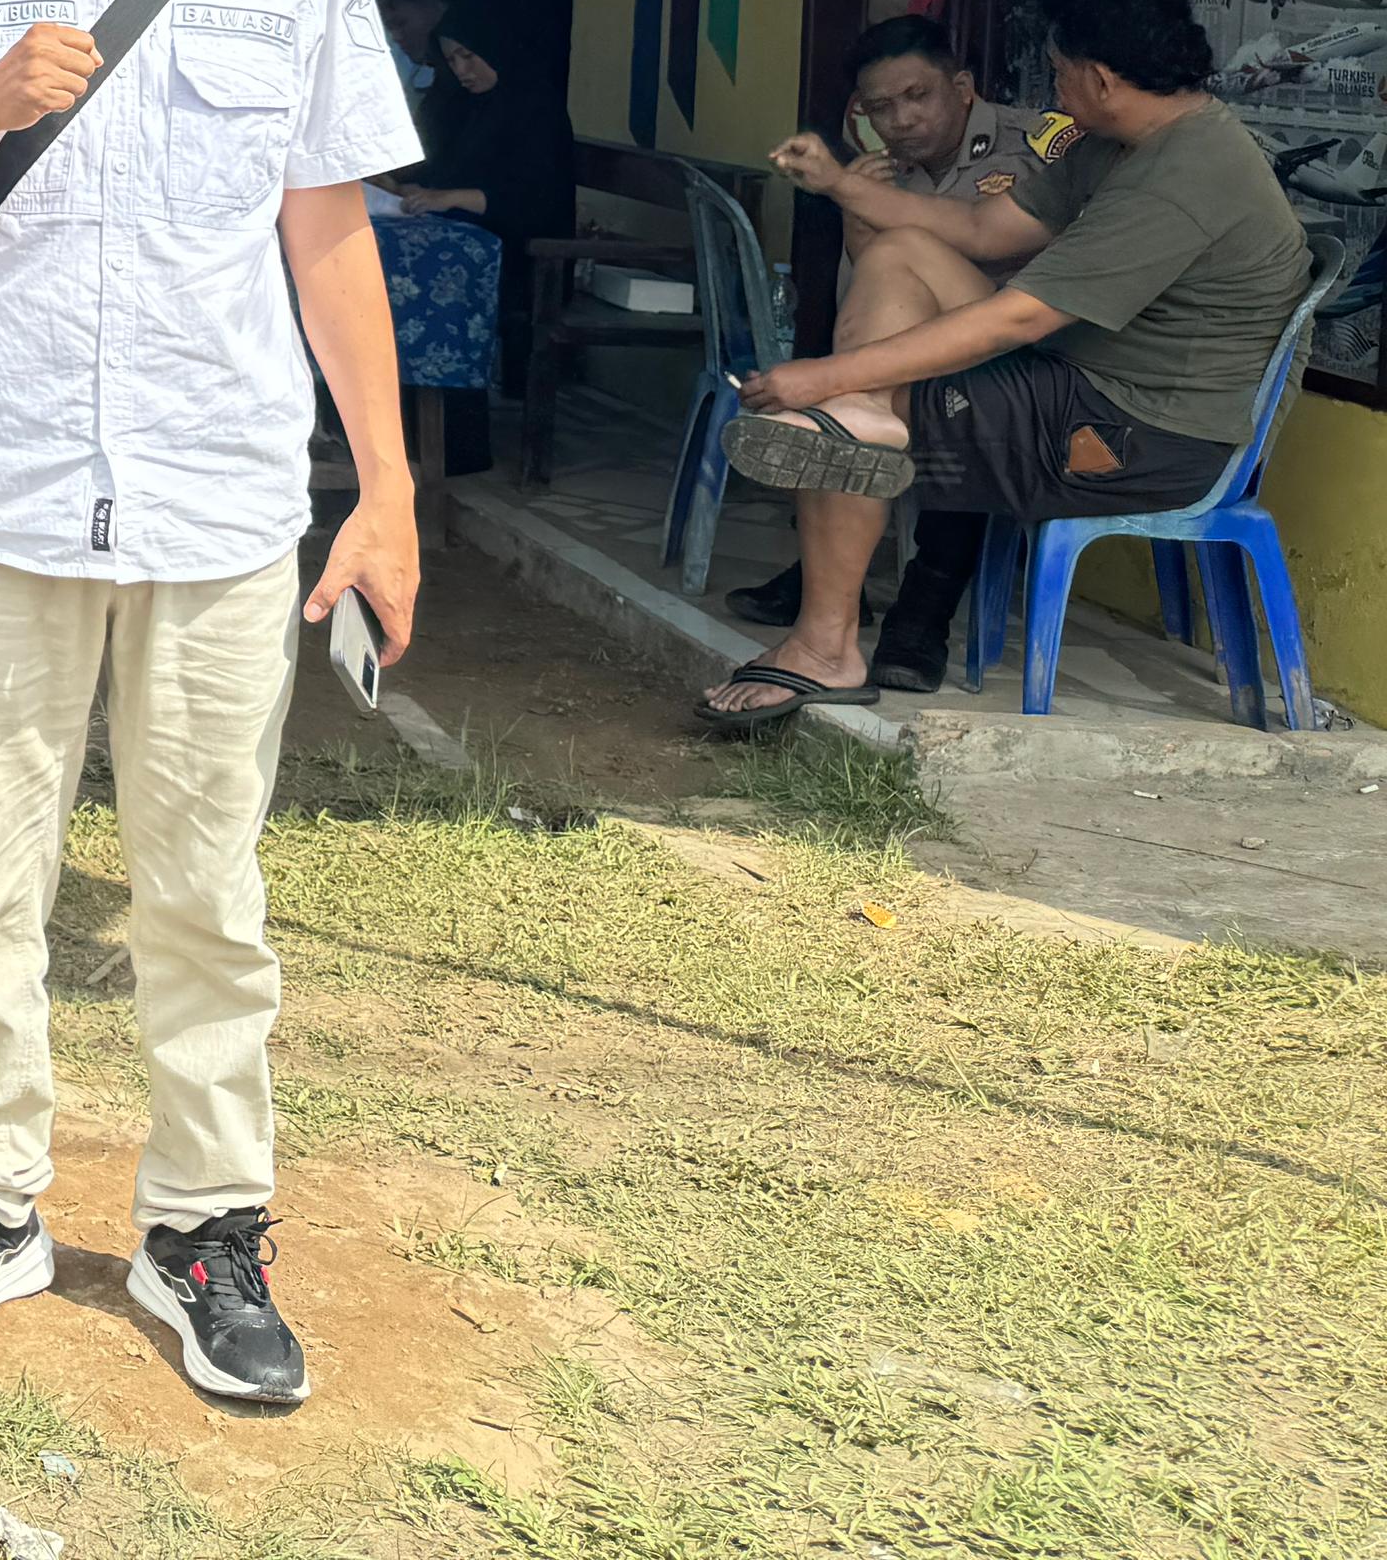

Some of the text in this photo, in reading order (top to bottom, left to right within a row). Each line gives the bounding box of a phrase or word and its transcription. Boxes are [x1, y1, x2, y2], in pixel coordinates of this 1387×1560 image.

[182, 5, 294, 39] BAWASLU
[1328, 68, 1375, 85] TURKISH
[1328, 82, 1375, 98] AIRLINES
